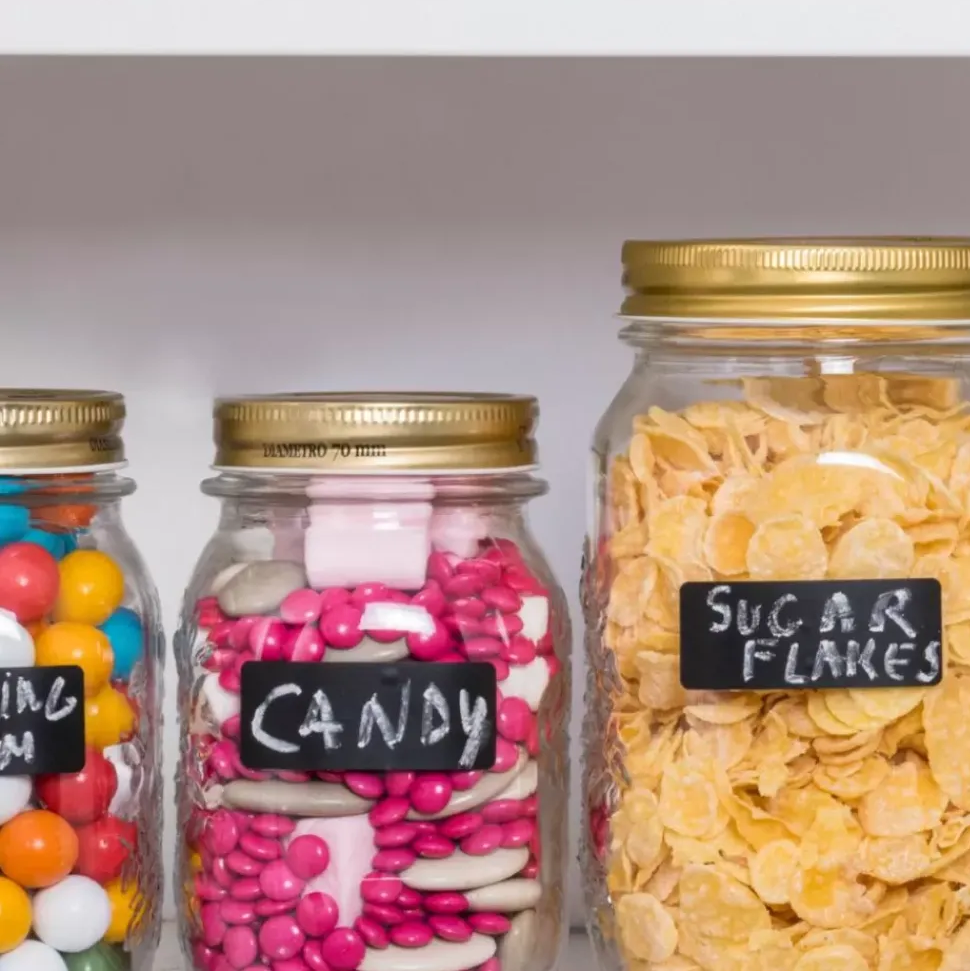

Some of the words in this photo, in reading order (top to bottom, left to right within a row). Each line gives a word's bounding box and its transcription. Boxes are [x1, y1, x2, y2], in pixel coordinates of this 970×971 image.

[262, 442, 328, 458] DIAMETRO
[331, 442, 351, 462] 70
[355, 443, 387, 457] mm
[706, 585, 917, 639] SUGAR
[742, 637, 941, 685] FLAKES
[251, 679, 488, 769] CANDY
